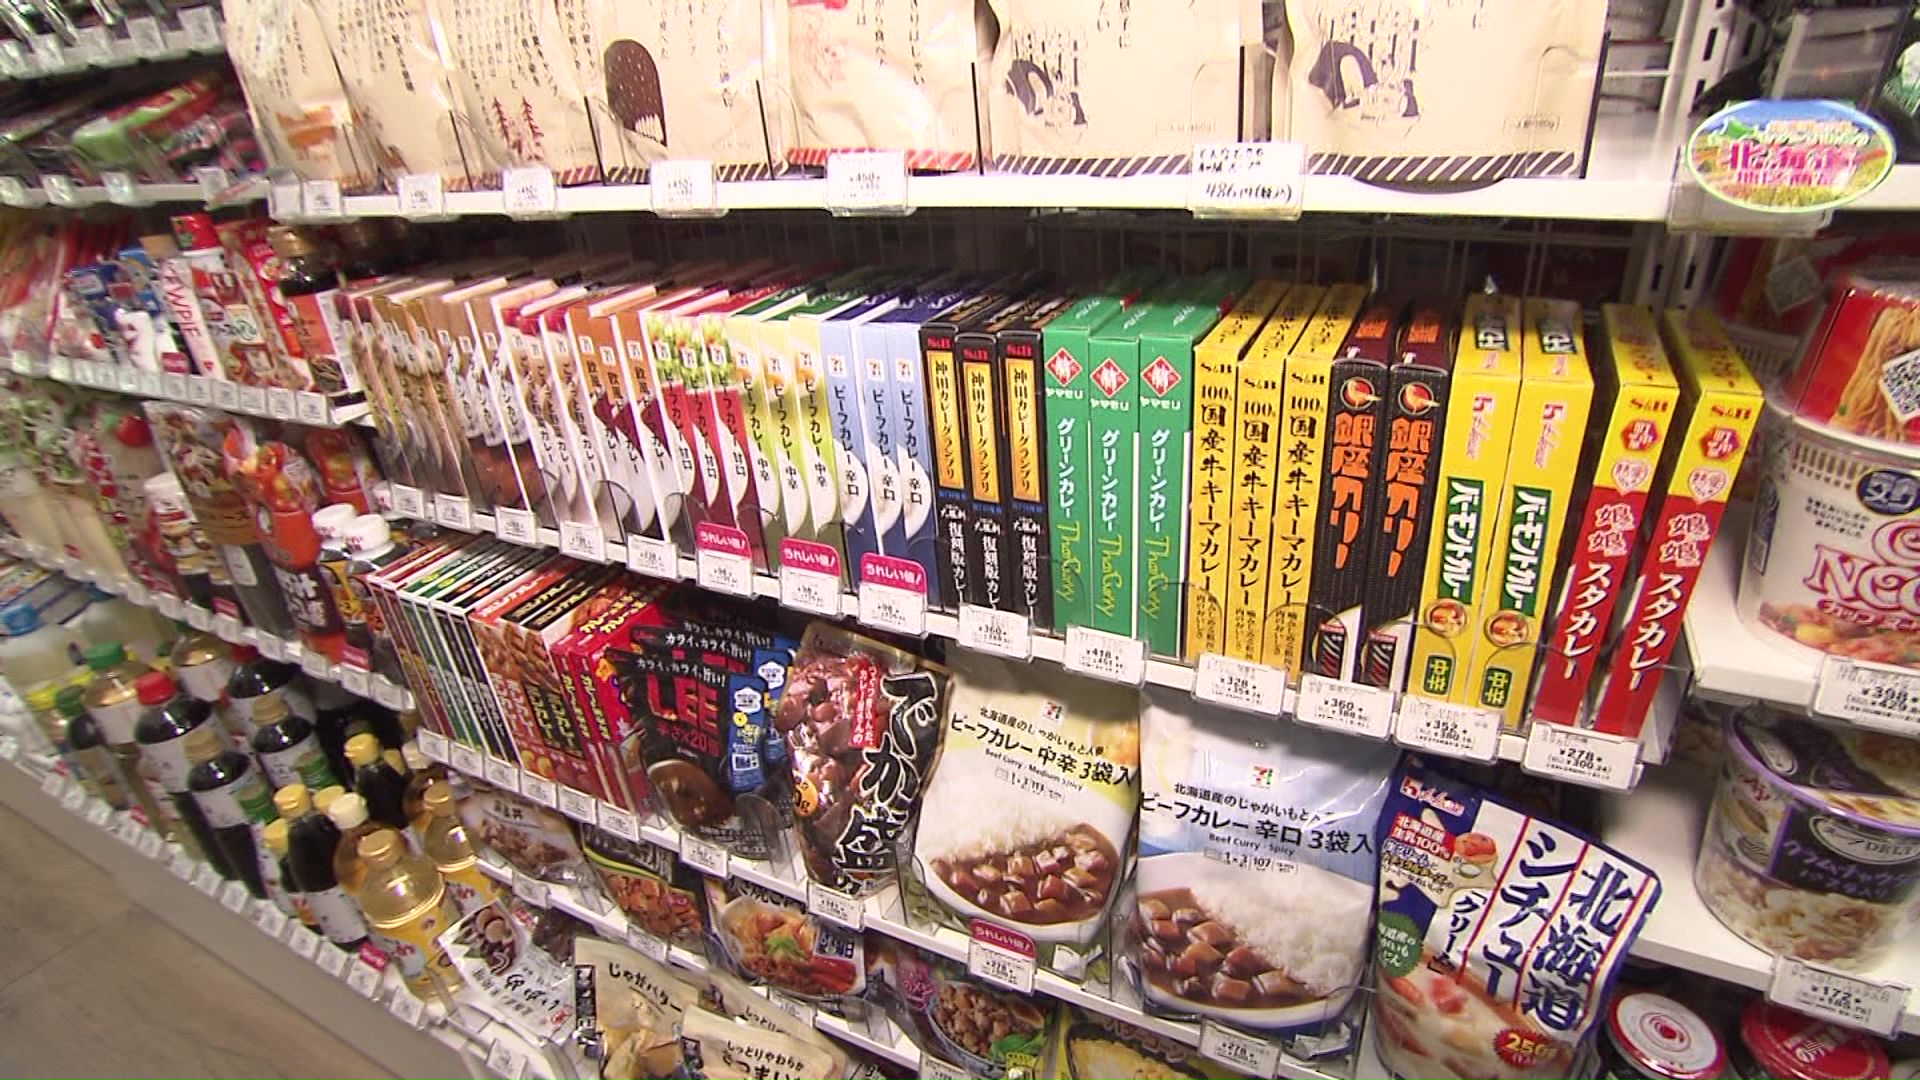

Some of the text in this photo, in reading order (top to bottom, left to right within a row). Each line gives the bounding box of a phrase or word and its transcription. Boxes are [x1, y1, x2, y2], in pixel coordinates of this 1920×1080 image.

[743, 378, 763, 452] ビーフカレー
[774, 383, 792, 461] ビーフカレー
[804, 377, 822, 457] ビーフカレー
[834, 385, 853, 464] ビーフカレー
[873, 388, 891, 469] ビーフカレー
[901, 388, 919, 471] ビーフカレー
[1058, 417, 1076, 518] グリーンカレー
[1101, 429, 1120, 532] グリーンカレー
[1150, 429, 1170, 533] グリーンカレー
[1198, 404, 1228, 592] 国産牛キーマカレー
[1238, 420, 1269, 605] 国産牛キーマカレー
[1280, 416, 1317, 607] 国産牛キーマカレー
[1330, 411, 1376, 570] 銀座カリー
[1383, 416, 1434, 577] 銀座カリー
[1443, 479, 1482, 598] バーモントカレー
[1505, 489, 1550, 610] バーモントカレー
[646, 673, 720, 736] LEE
[951, 711, 1132, 787] ビーフカレー 中辛 3袋入
[1559, 747, 1595, 763] ¥278
[1140, 791, 1374, 855] ビーフカレー 辛口 3袋入
[1209, 833, 1231, 845] Beef
[1233, 837, 1260, 850] Curry
[1483, 830, 1577, 998] シチュー
[1521, 861, 1634, 1032] 北海道
